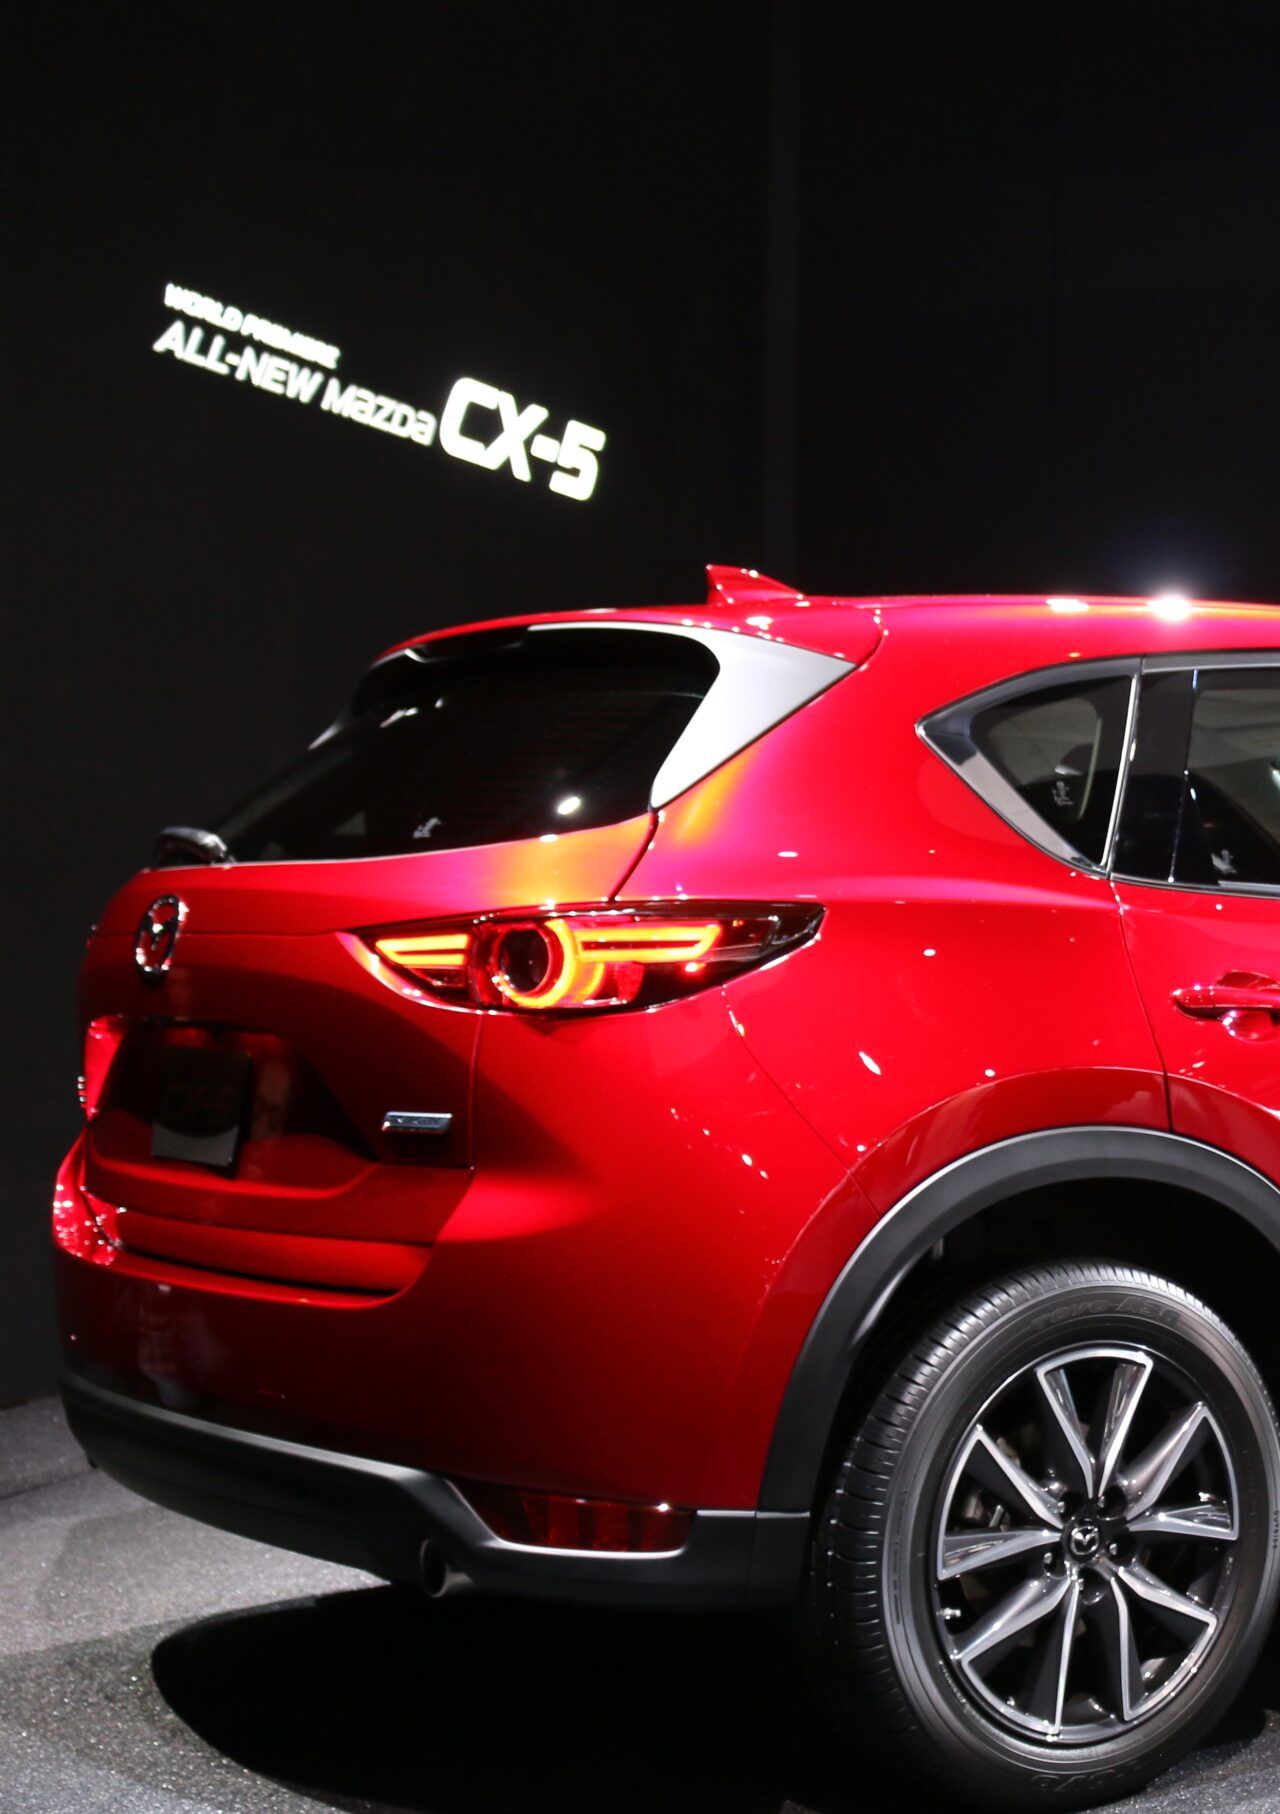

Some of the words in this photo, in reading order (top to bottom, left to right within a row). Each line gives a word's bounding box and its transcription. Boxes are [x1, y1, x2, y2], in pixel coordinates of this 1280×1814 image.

[164, 284, 243, 331] WORLD
[153, 320, 324, 403] ALL-NEW
[439, 377, 606, 501] CX-5
